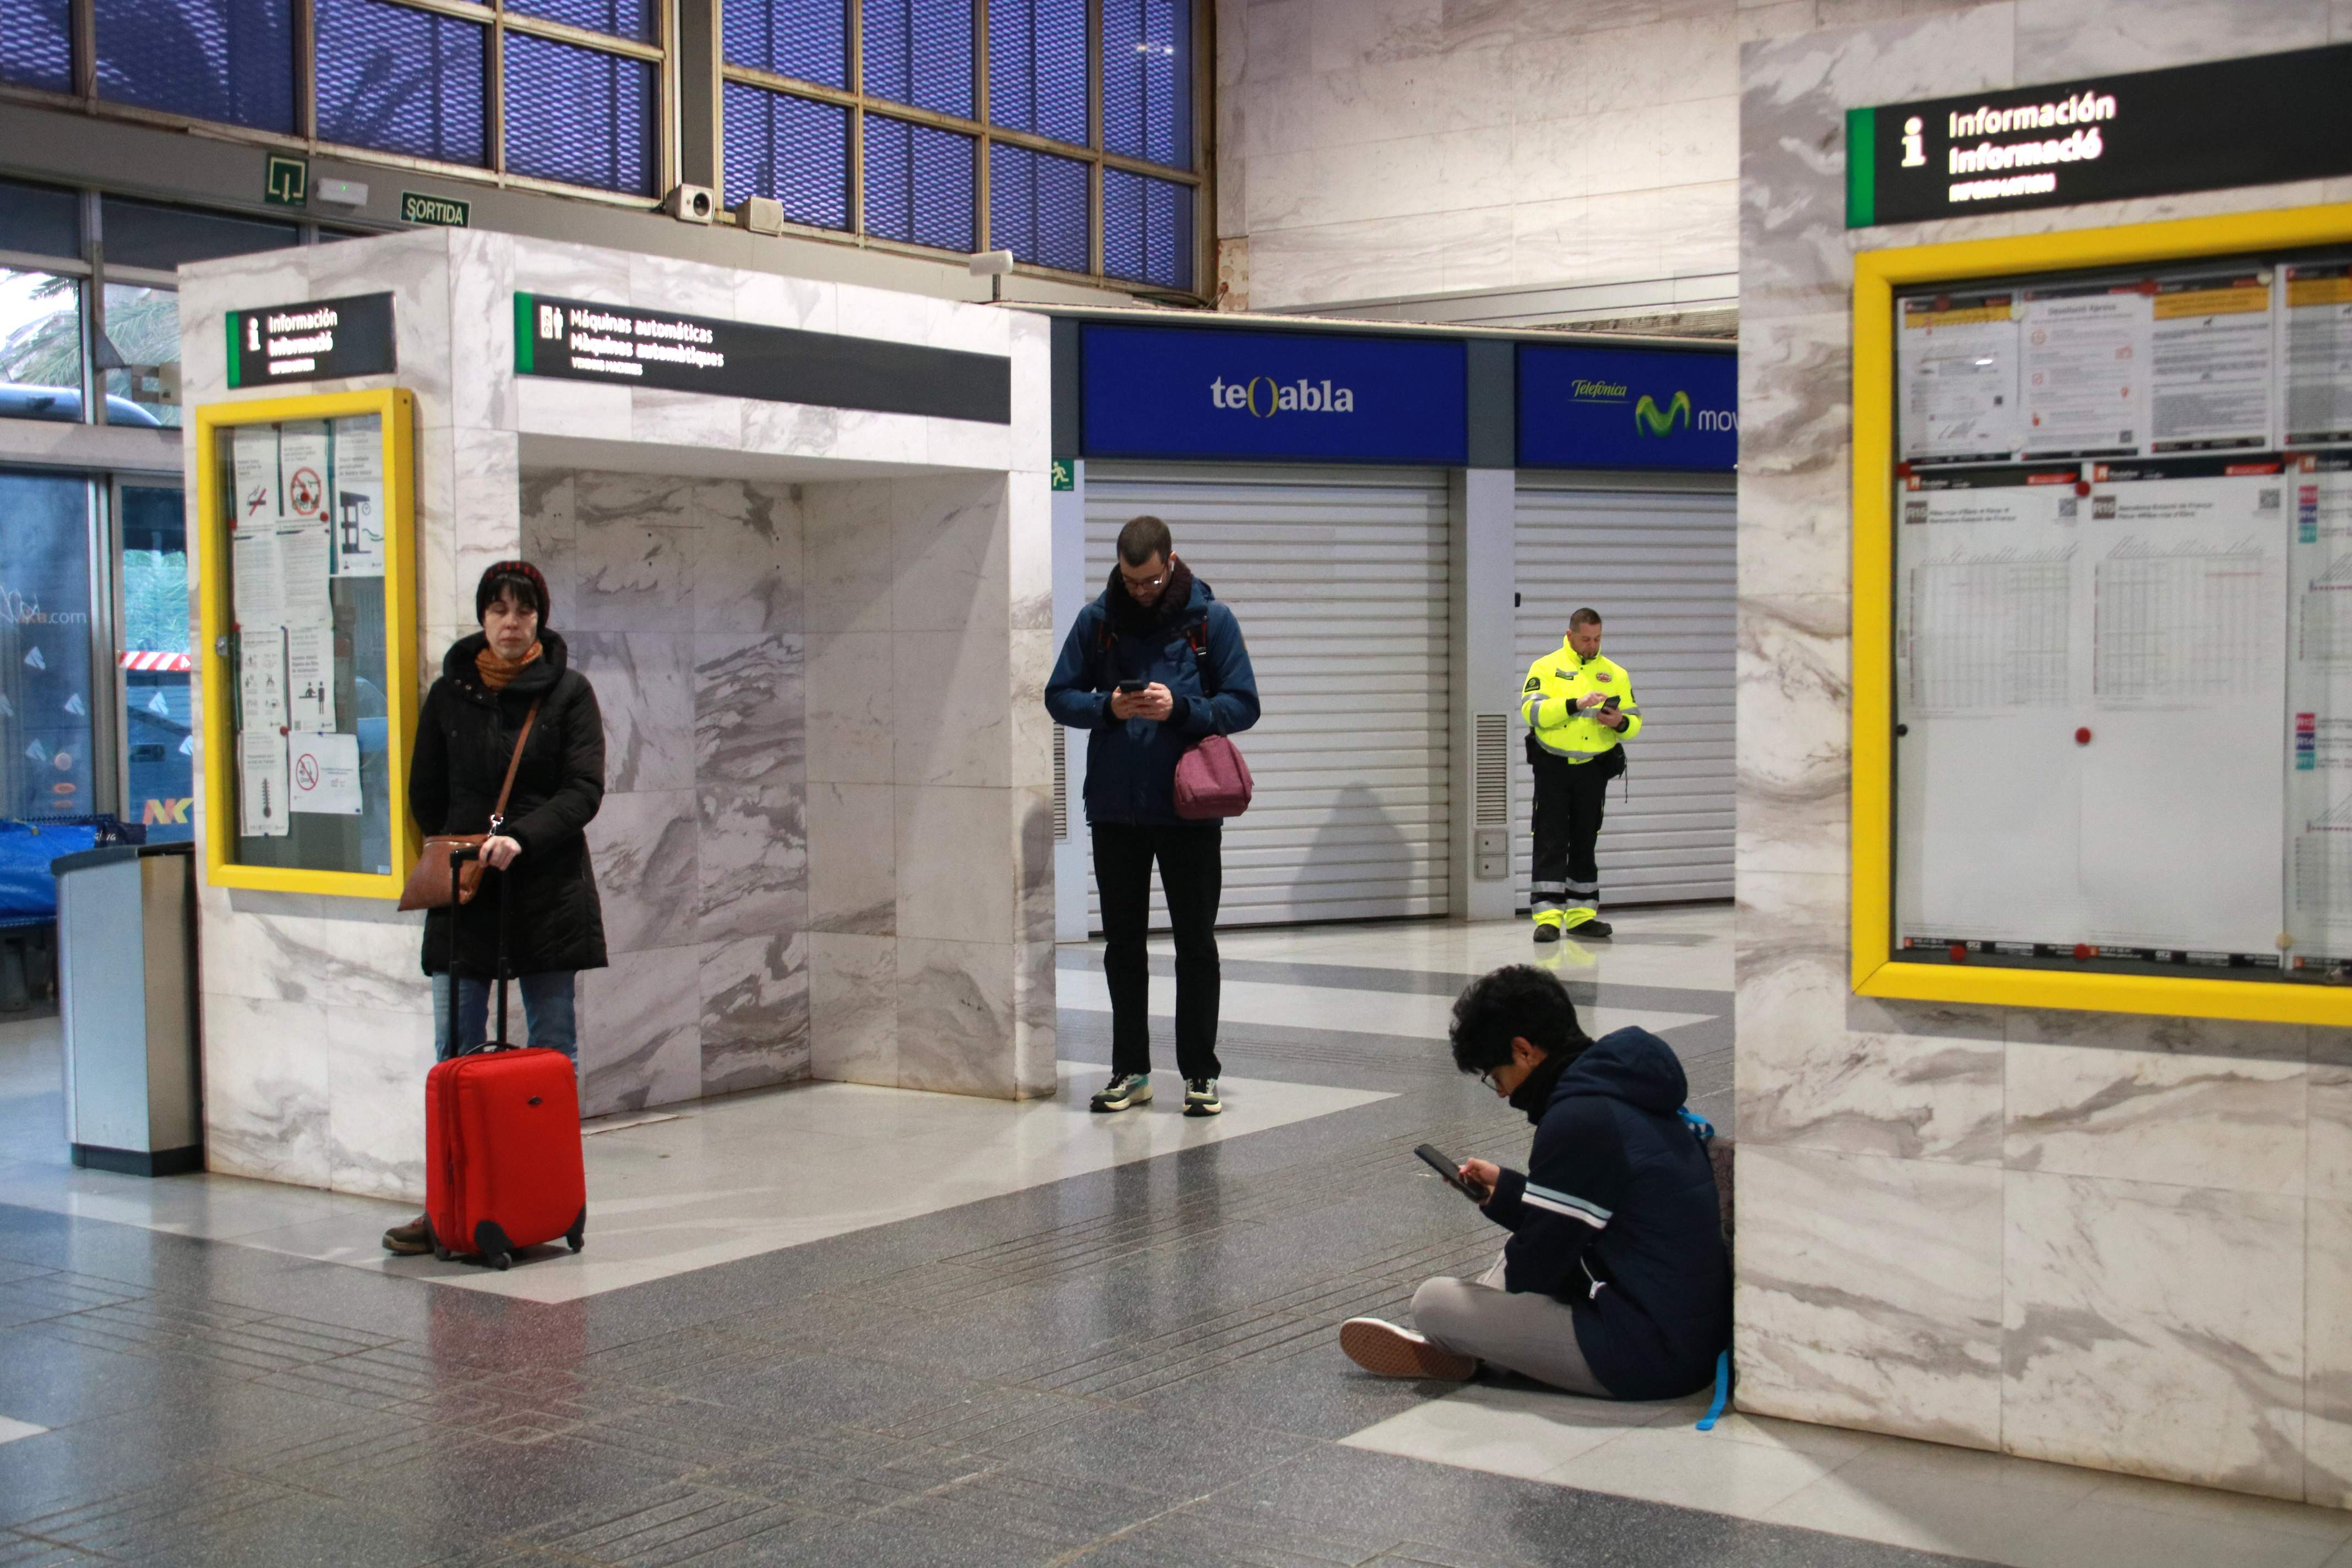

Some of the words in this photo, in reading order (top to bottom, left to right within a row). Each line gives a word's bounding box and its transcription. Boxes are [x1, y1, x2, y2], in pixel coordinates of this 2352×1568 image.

[1949, 91, 2116, 138] Información
[1948, 127, 2103, 175] Informació
[406, 197, 464, 225] SORTIDA
[268, 308, 338, 333] Información
[570, 308, 632, 334] Máquinas
[635, 319, 714, 344] automáticas
[268, 331, 333, 357] Informació
[570, 332, 633, 357] Màquines
